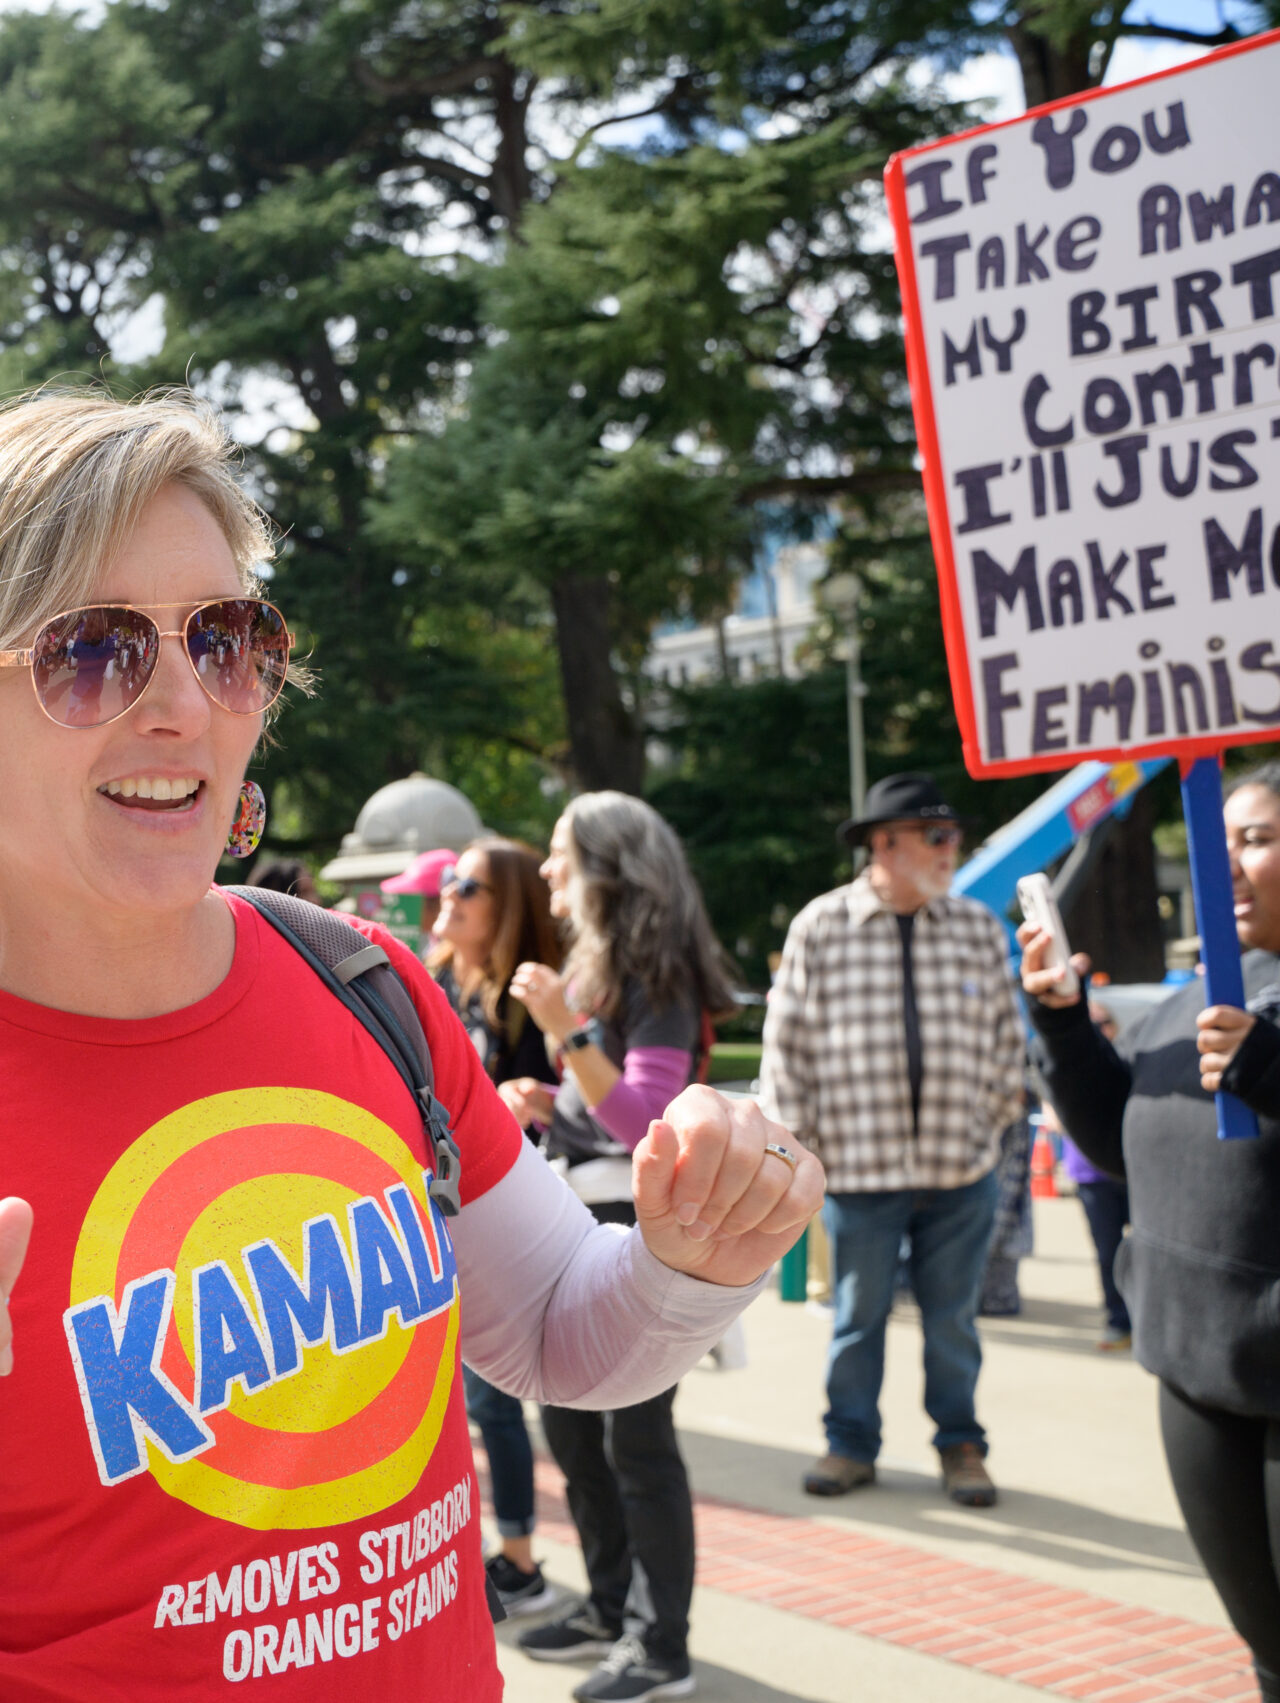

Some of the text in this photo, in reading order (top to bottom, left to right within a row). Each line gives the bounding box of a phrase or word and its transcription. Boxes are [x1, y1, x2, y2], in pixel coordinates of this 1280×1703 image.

[941, 308, 1026, 387] MY
[1023, 342, 1280, 449] Contr
[1095, 419, 1280, 509] JUS
[970, 506, 1280, 639] MAKE M
[154, 1472, 471, 1628] REMOVES STUBBORN
[222, 1550, 458, 1682] ORANGE STAINS
